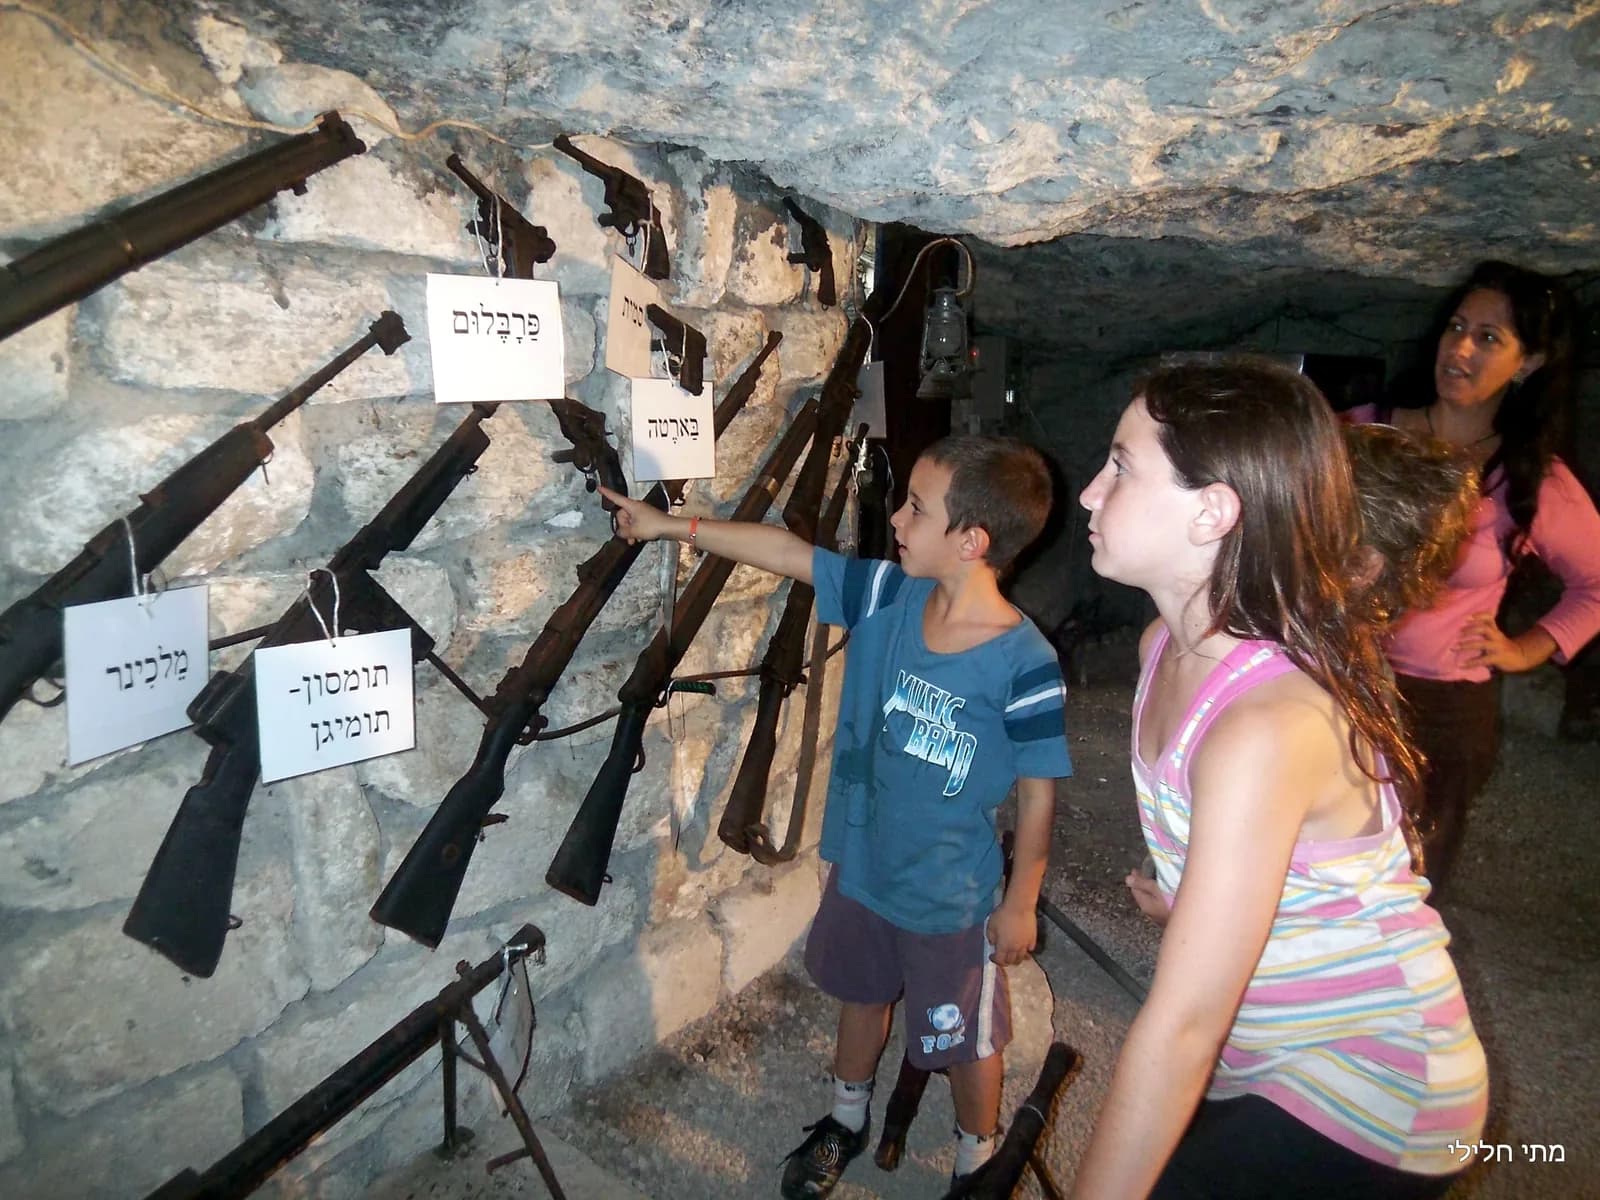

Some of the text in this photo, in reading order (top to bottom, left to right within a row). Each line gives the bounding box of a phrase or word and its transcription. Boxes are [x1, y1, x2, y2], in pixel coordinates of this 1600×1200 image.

[288, 664, 389, 705] תומסון-
[882, 669, 966, 729] MUSIC
[310, 710, 390, 752] תומיגן
[903, 717, 978, 797] BAND
[920, 1025, 966, 1054] FOX
